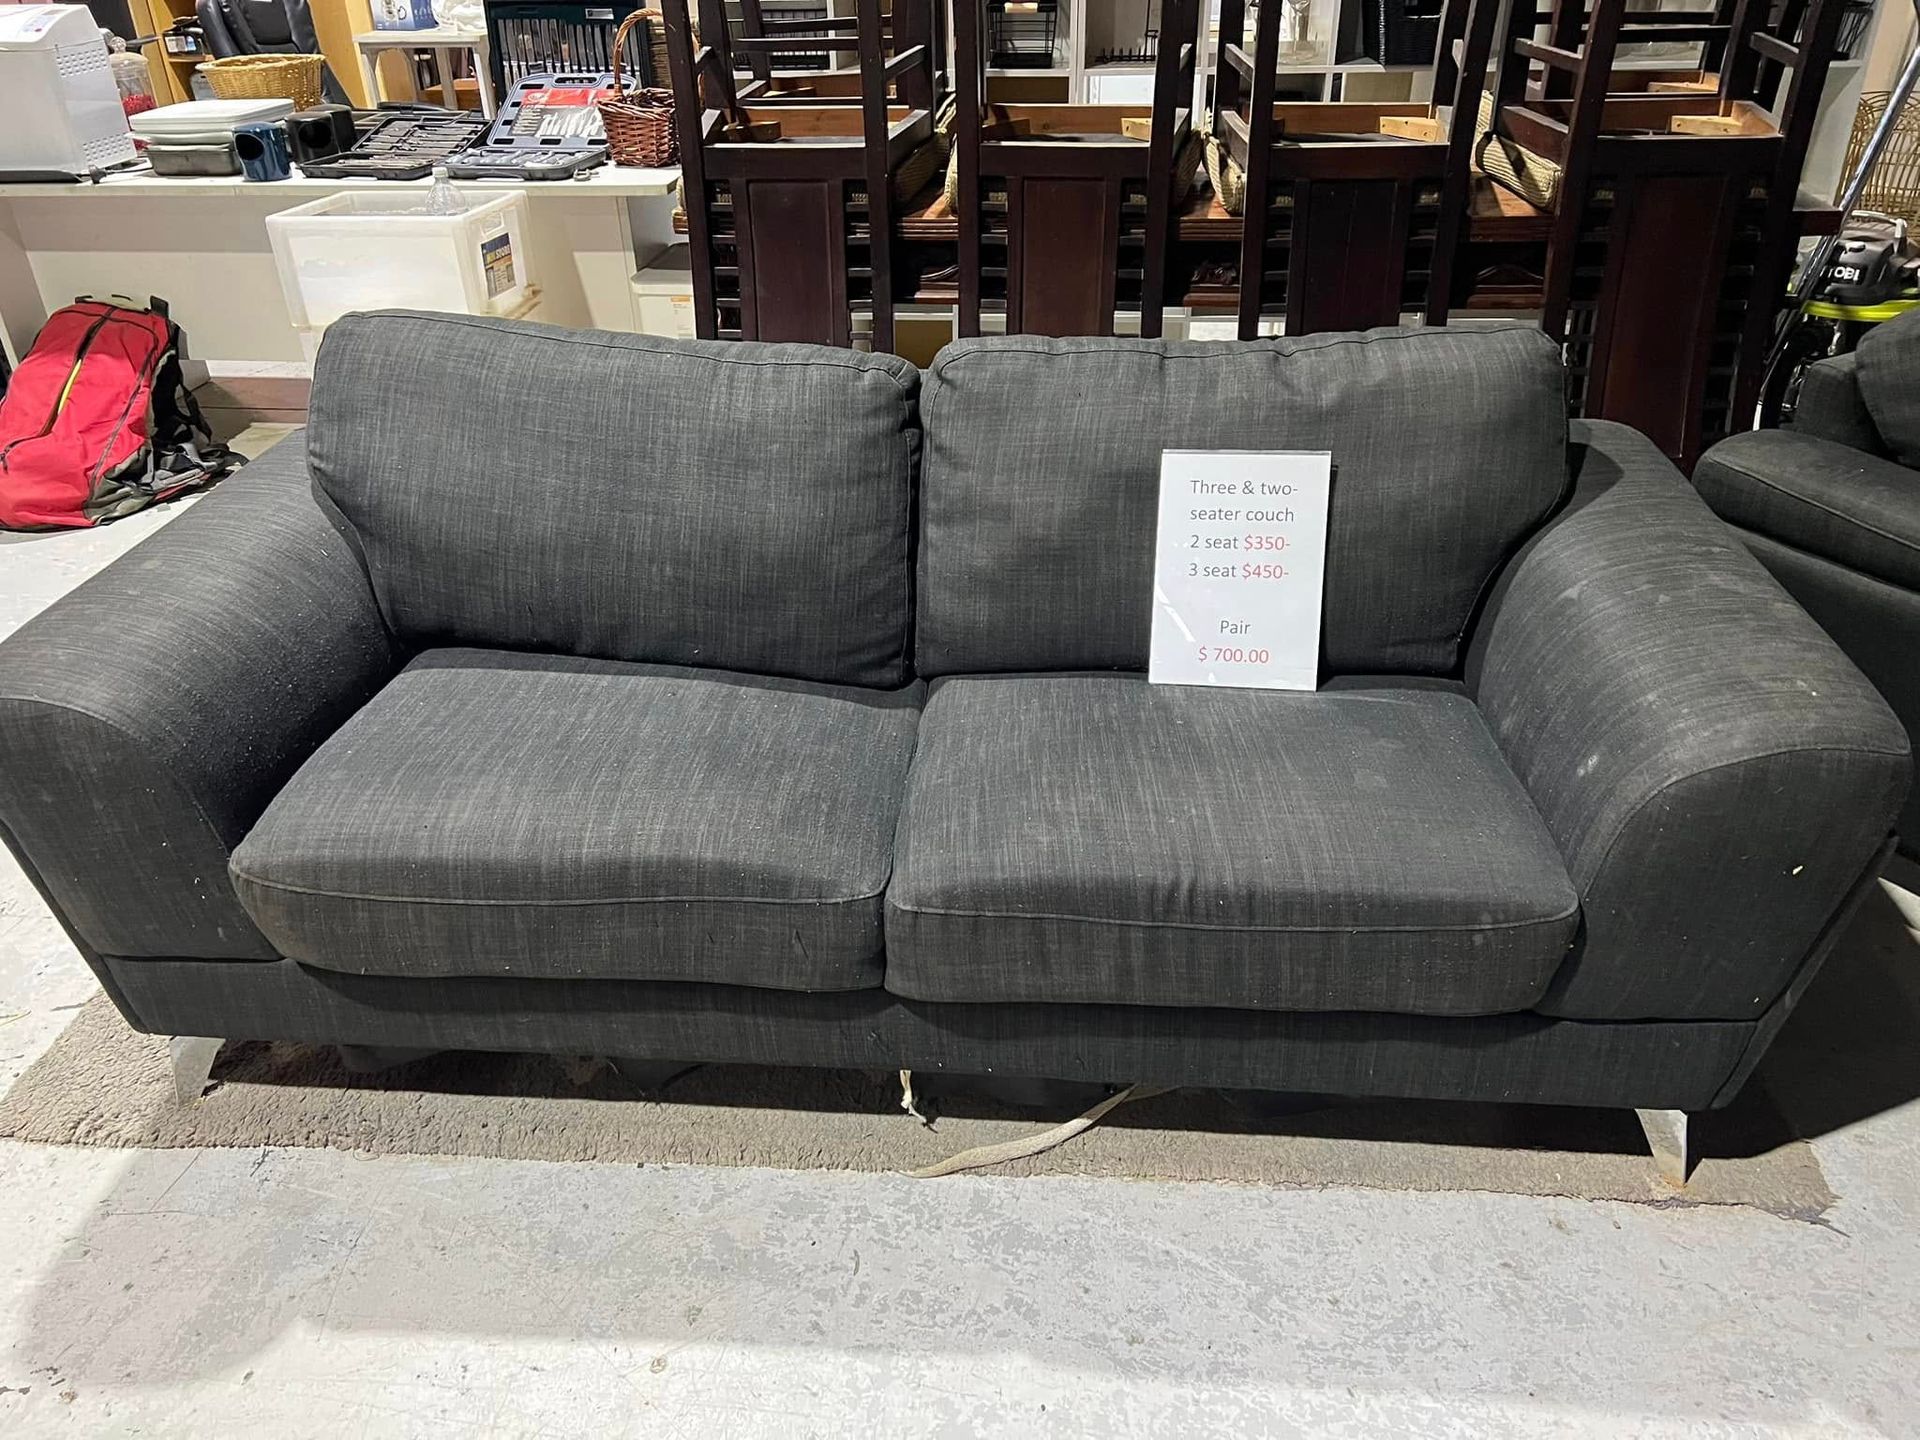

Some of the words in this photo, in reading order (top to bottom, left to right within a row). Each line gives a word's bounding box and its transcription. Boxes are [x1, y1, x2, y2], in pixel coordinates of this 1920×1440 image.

[1190, 480, 1237, 495] Three
[1241, 480, 1255, 495] &
[1260, 482, 1299, 496] two-
[1190, 507, 1242, 521] seater
[1245, 507, 1295, 523] couch
[1190, 534, 1200, 549] 2
[1204, 536, 1239, 550] seat
[1243, 534, 1291, 551] $350-
[1188, 562, 1198, 577] 3
[1202, 564, 1237, 578] seat
[1241, 562, 1290, 580] $450-
[1219, 620, 1251, 635] Pair
[1198, 646, 1208, 663] $
[1213, 647, 1269, 664] 700.00
